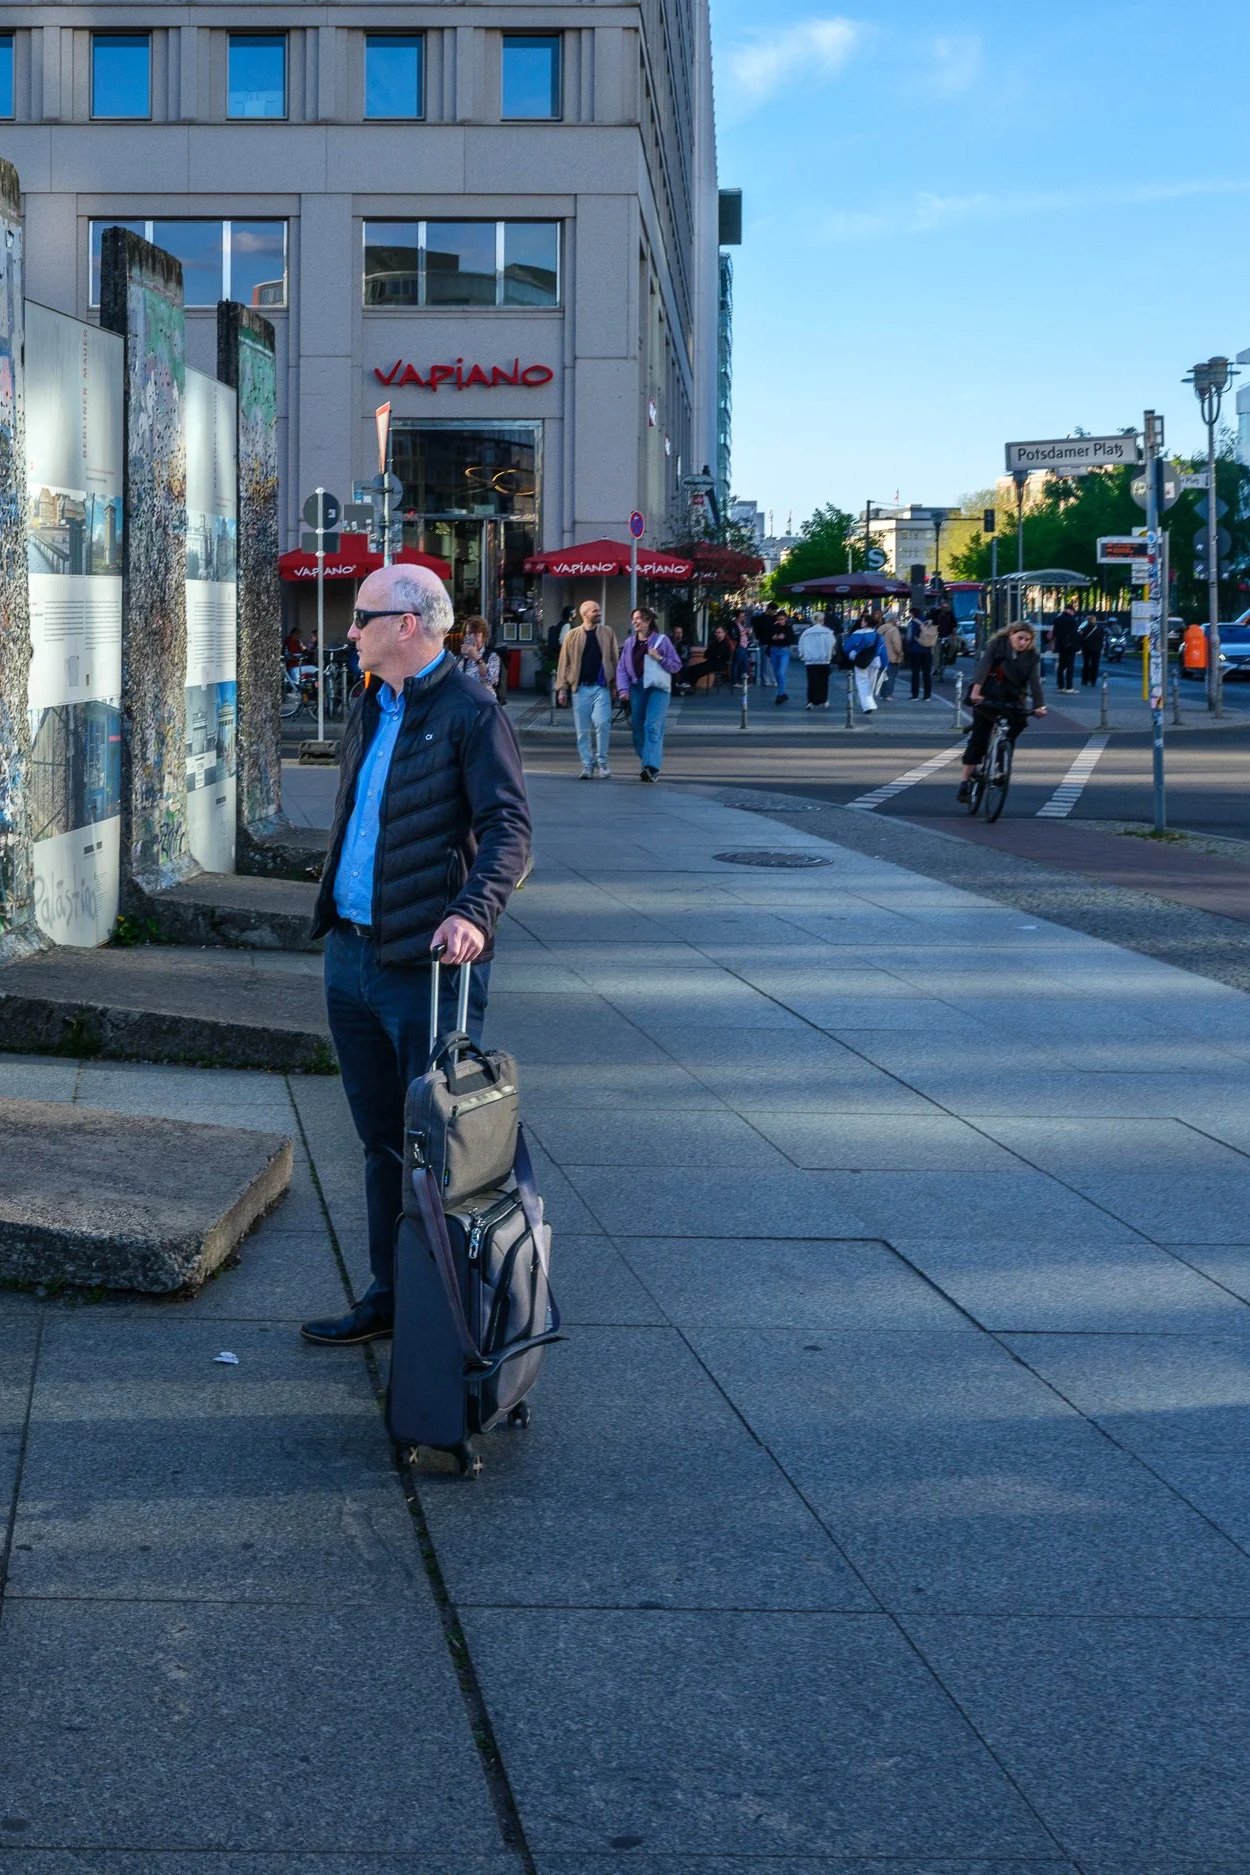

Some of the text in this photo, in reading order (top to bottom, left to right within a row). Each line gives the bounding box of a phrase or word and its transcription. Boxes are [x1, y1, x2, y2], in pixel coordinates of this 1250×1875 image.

[1017, 442, 1124, 462] Potsdamer Platz
[868, 549, 886, 568] S
[294, 564, 354, 578] VAPANO
